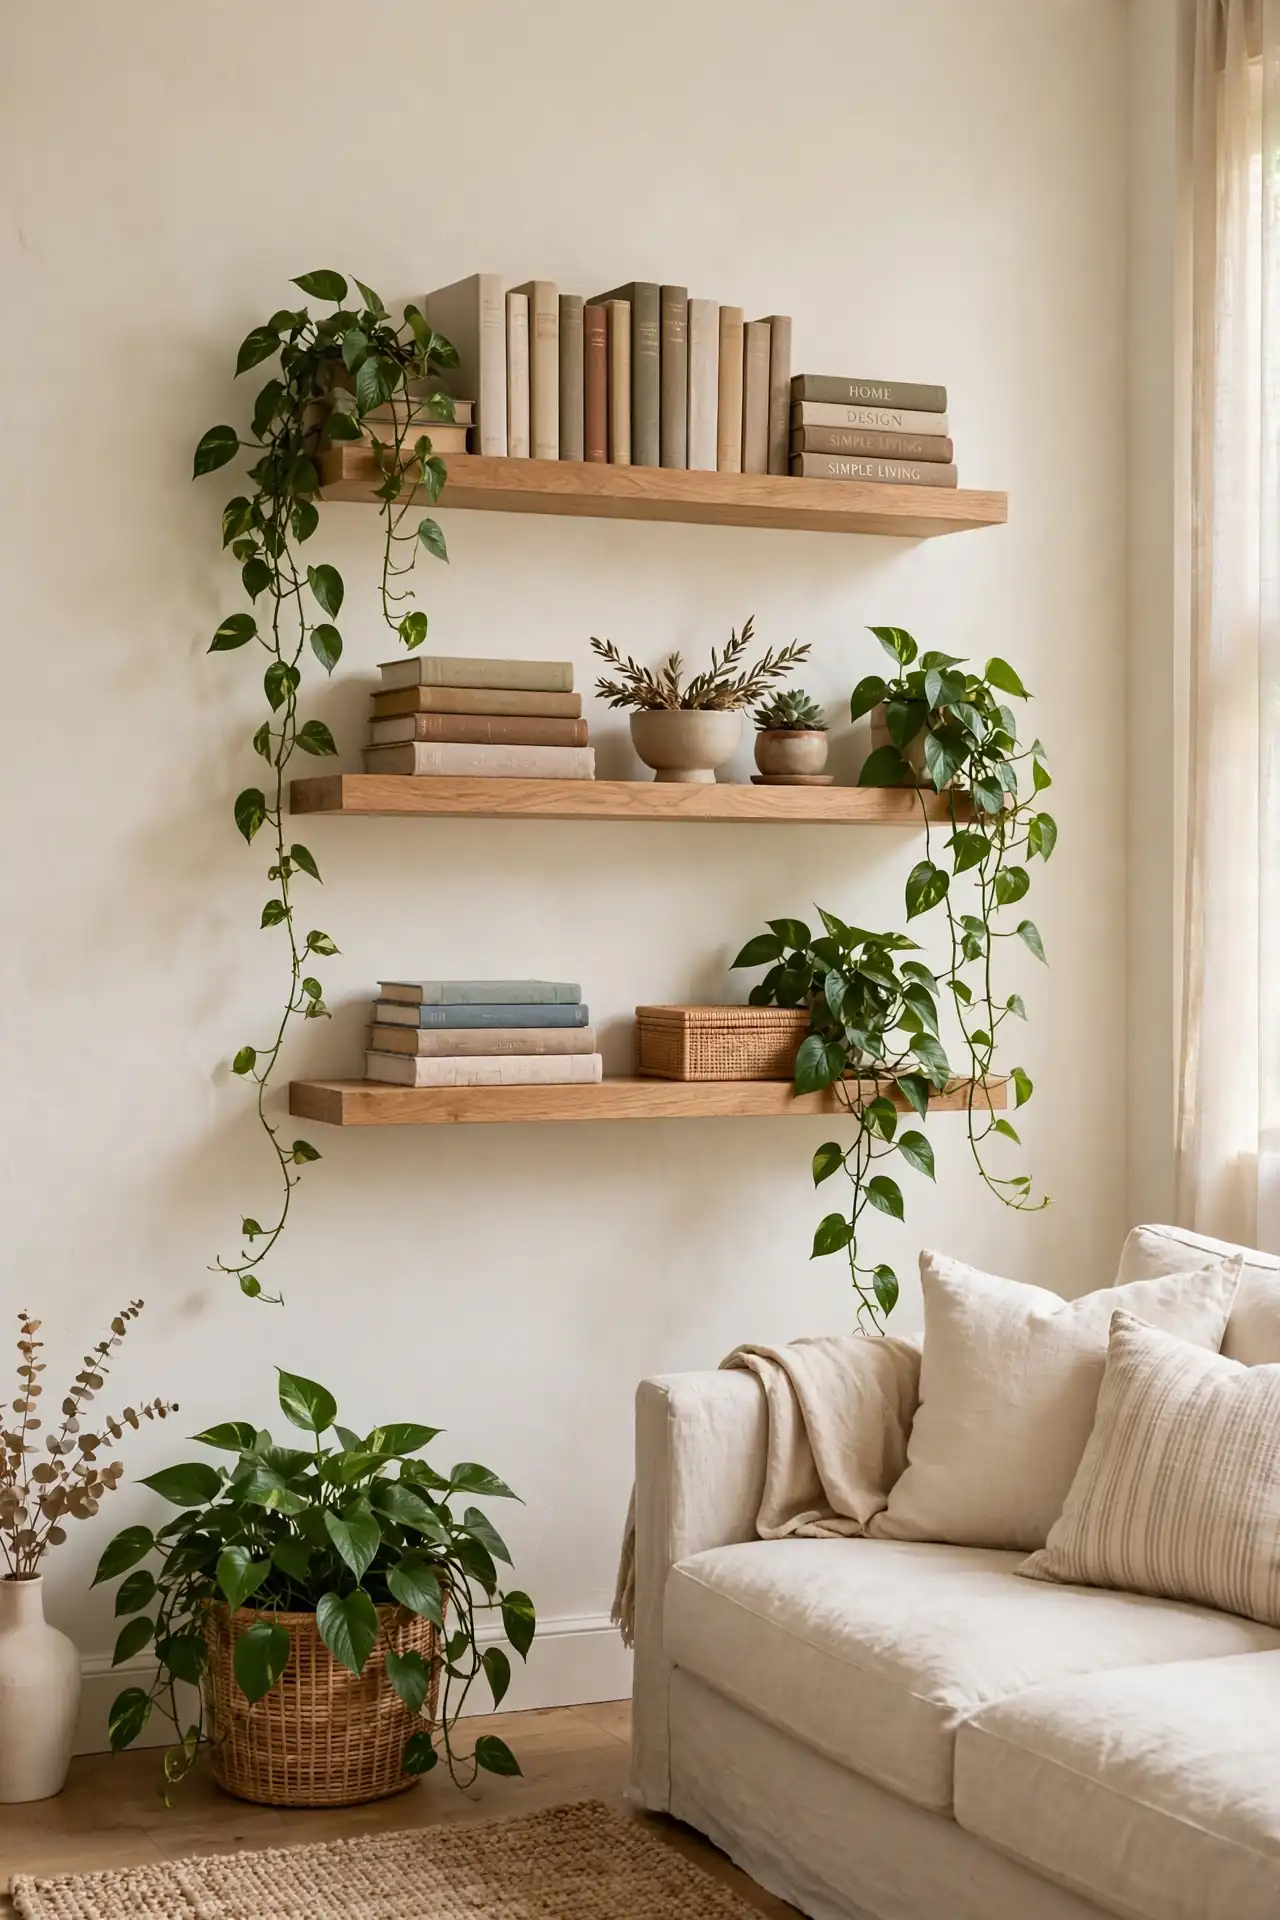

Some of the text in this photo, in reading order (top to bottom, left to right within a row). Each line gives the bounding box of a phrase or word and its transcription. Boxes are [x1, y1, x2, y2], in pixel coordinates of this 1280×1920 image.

[849, 385, 892, 400] HOME
[847, 410, 902, 426] DESIGN
[829, 434, 922, 453] SIMPLE LIVING
[828, 462, 921, 480] SIMPLE LIVING
